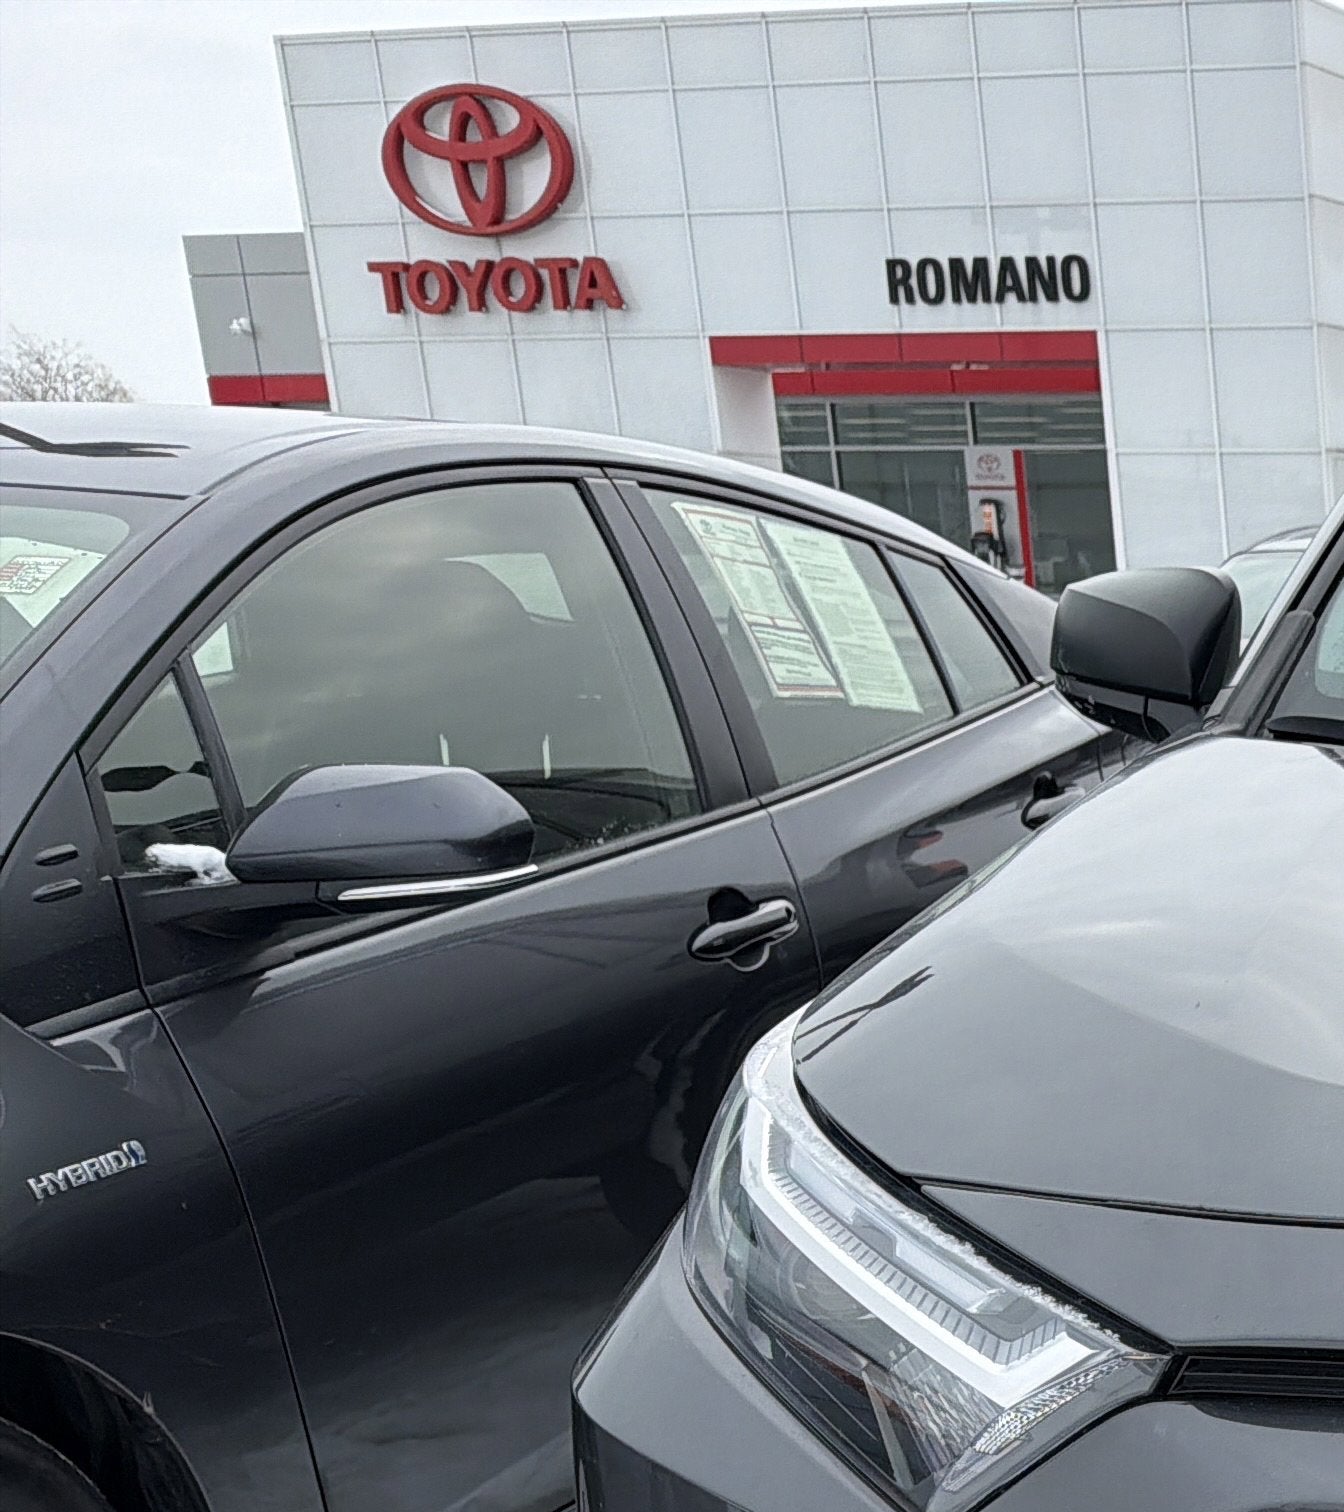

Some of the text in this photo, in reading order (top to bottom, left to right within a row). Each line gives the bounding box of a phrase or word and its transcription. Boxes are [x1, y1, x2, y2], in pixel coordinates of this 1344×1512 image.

[367, 257, 627, 315] TOYOTA
[886, 254, 1092, 306] ROMANO
[27, 1150, 129, 1200] HYBRID
